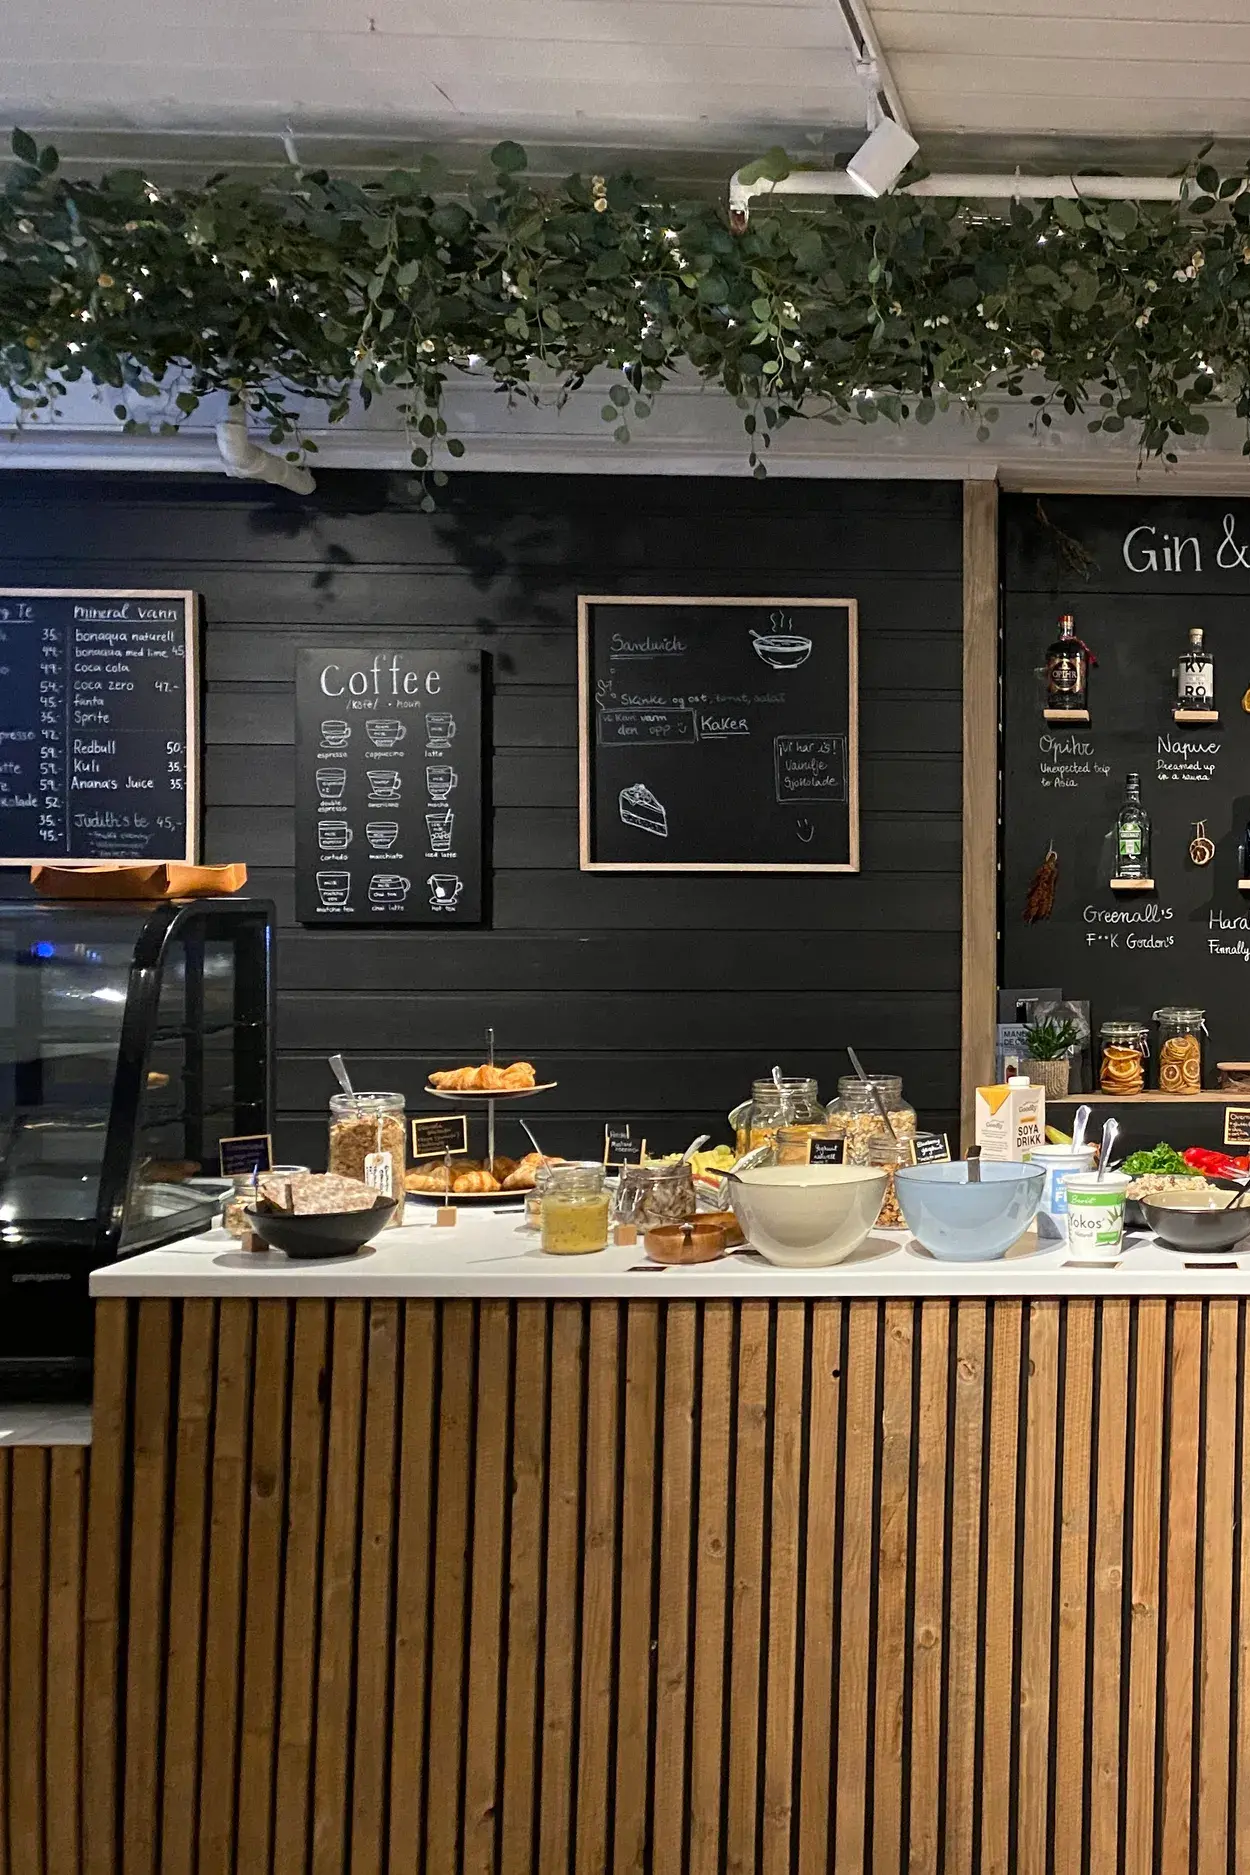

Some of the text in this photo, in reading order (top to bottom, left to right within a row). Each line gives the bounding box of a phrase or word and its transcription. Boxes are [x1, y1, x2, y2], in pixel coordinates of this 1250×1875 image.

[1123, 526, 1203, 573] Gin
[75, 628, 174, 647] bonaqua naturell
[611, 633, 687, 652] Sandwich
[320, 654, 441, 696] Coffee
[73, 739, 116, 755] Redbull
[1040, 763, 1091, 781] Unexpected
[1156, 759, 1201, 771] Dreamed
[1018, 1124, 1039, 1136] SOYA
[1016, 1134, 1042, 1148] DRIKK
